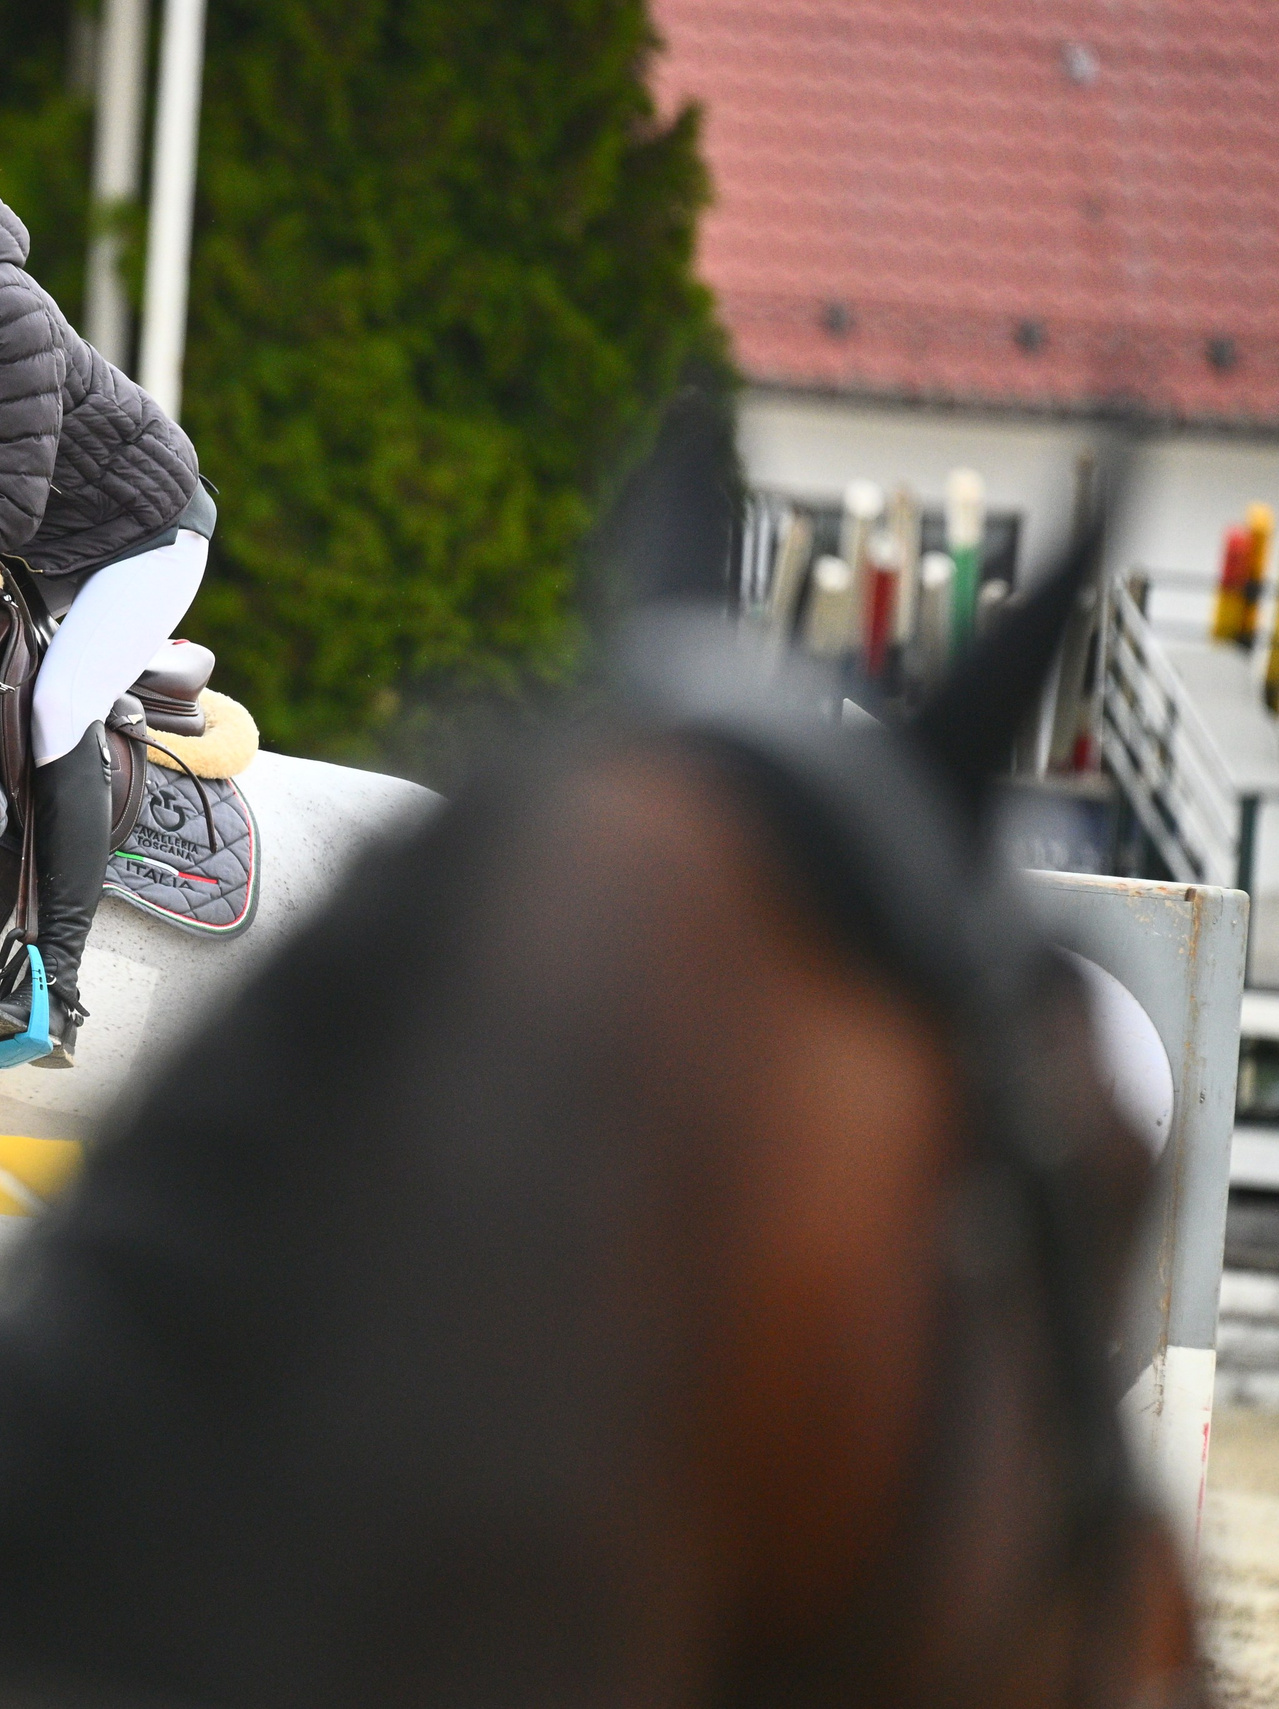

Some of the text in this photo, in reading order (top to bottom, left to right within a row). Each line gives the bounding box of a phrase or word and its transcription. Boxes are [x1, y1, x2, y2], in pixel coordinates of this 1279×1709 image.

[133, 825, 198, 854] CAVALLERIA
[137, 835, 193, 862] TOSCANA
[126, 861, 195, 891] ITALIA
